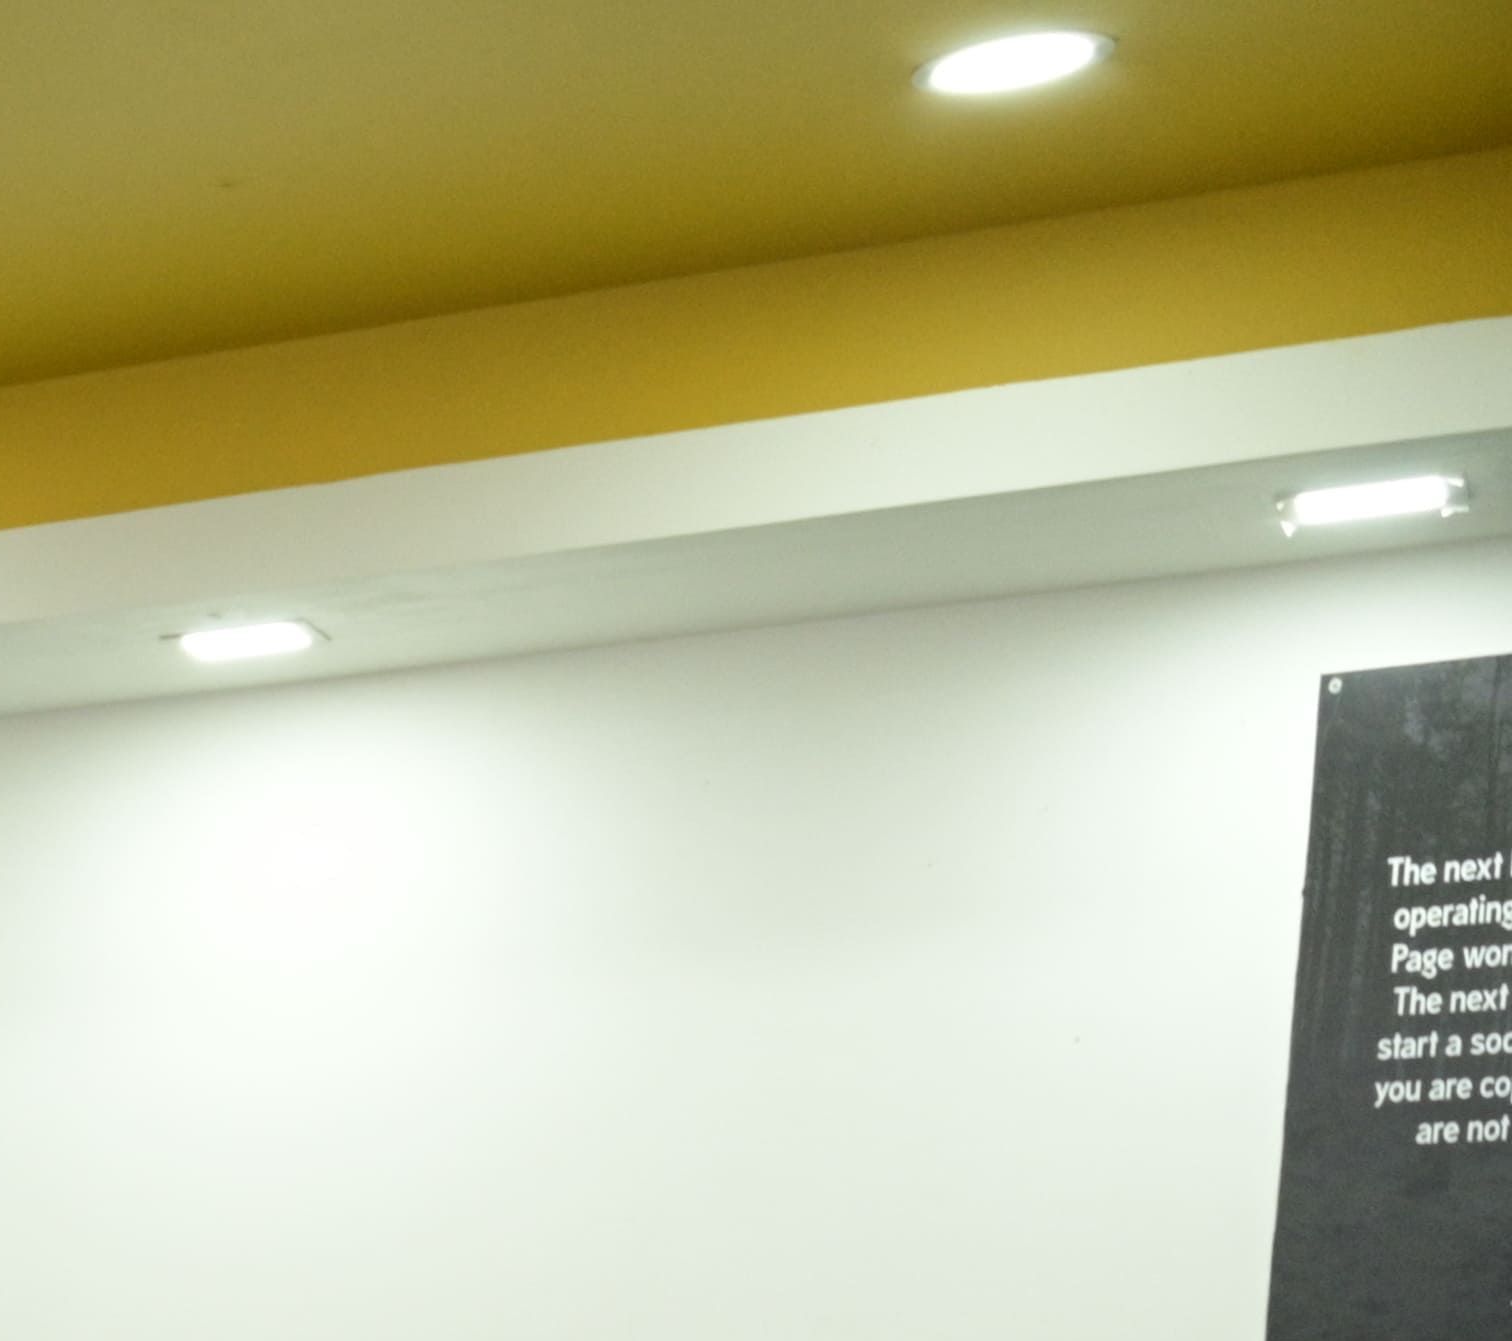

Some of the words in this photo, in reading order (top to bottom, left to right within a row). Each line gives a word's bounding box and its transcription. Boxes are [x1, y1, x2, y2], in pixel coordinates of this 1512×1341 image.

[1387, 855, 1438, 888] The
[1443, 850, 1505, 884] next
[1394, 893, 1512, 938] operating
[1390, 942, 1455, 980] Page
[1393, 985, 1443, 1017] The
[1450, 982, 1510, 1014] next
[1376, 1031, 1440, 1061] start
[1445, 1034, 1463, 1057] a
[1374, 1079, 1423, 1109] you
[1428, 1077, 1474, 1102] are
[1479, 1075, 1512, 1104] co
[1415, 1120, 1461, 1145] are
[1467, 1113, 1511, 1143] not
